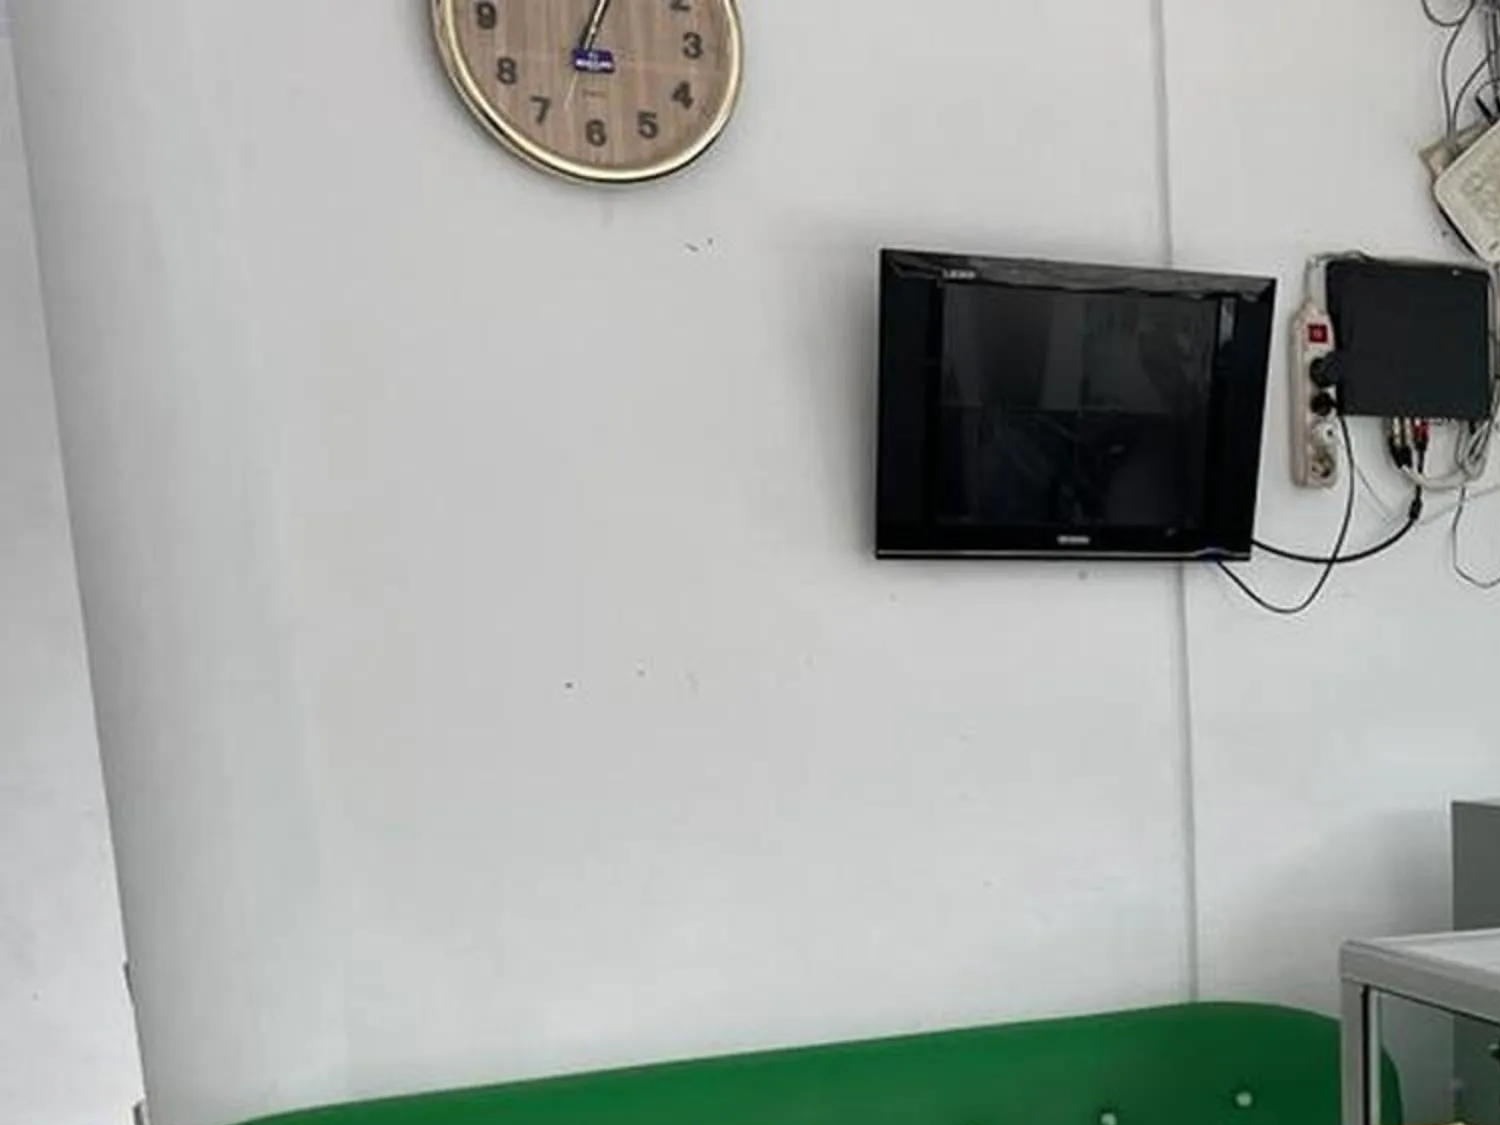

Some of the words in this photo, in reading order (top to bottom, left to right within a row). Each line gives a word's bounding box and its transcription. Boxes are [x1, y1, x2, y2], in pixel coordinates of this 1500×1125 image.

[476, 0, 497, 29] 9
[682, 32, 703, 59] 3
[497, 58, 518, 85] 8
[673, 81, 695, 109] 4
[531, 97, 551, 124] 7
[586, 119, 606, 147] 6
[638, 112, 659, 139] 5
